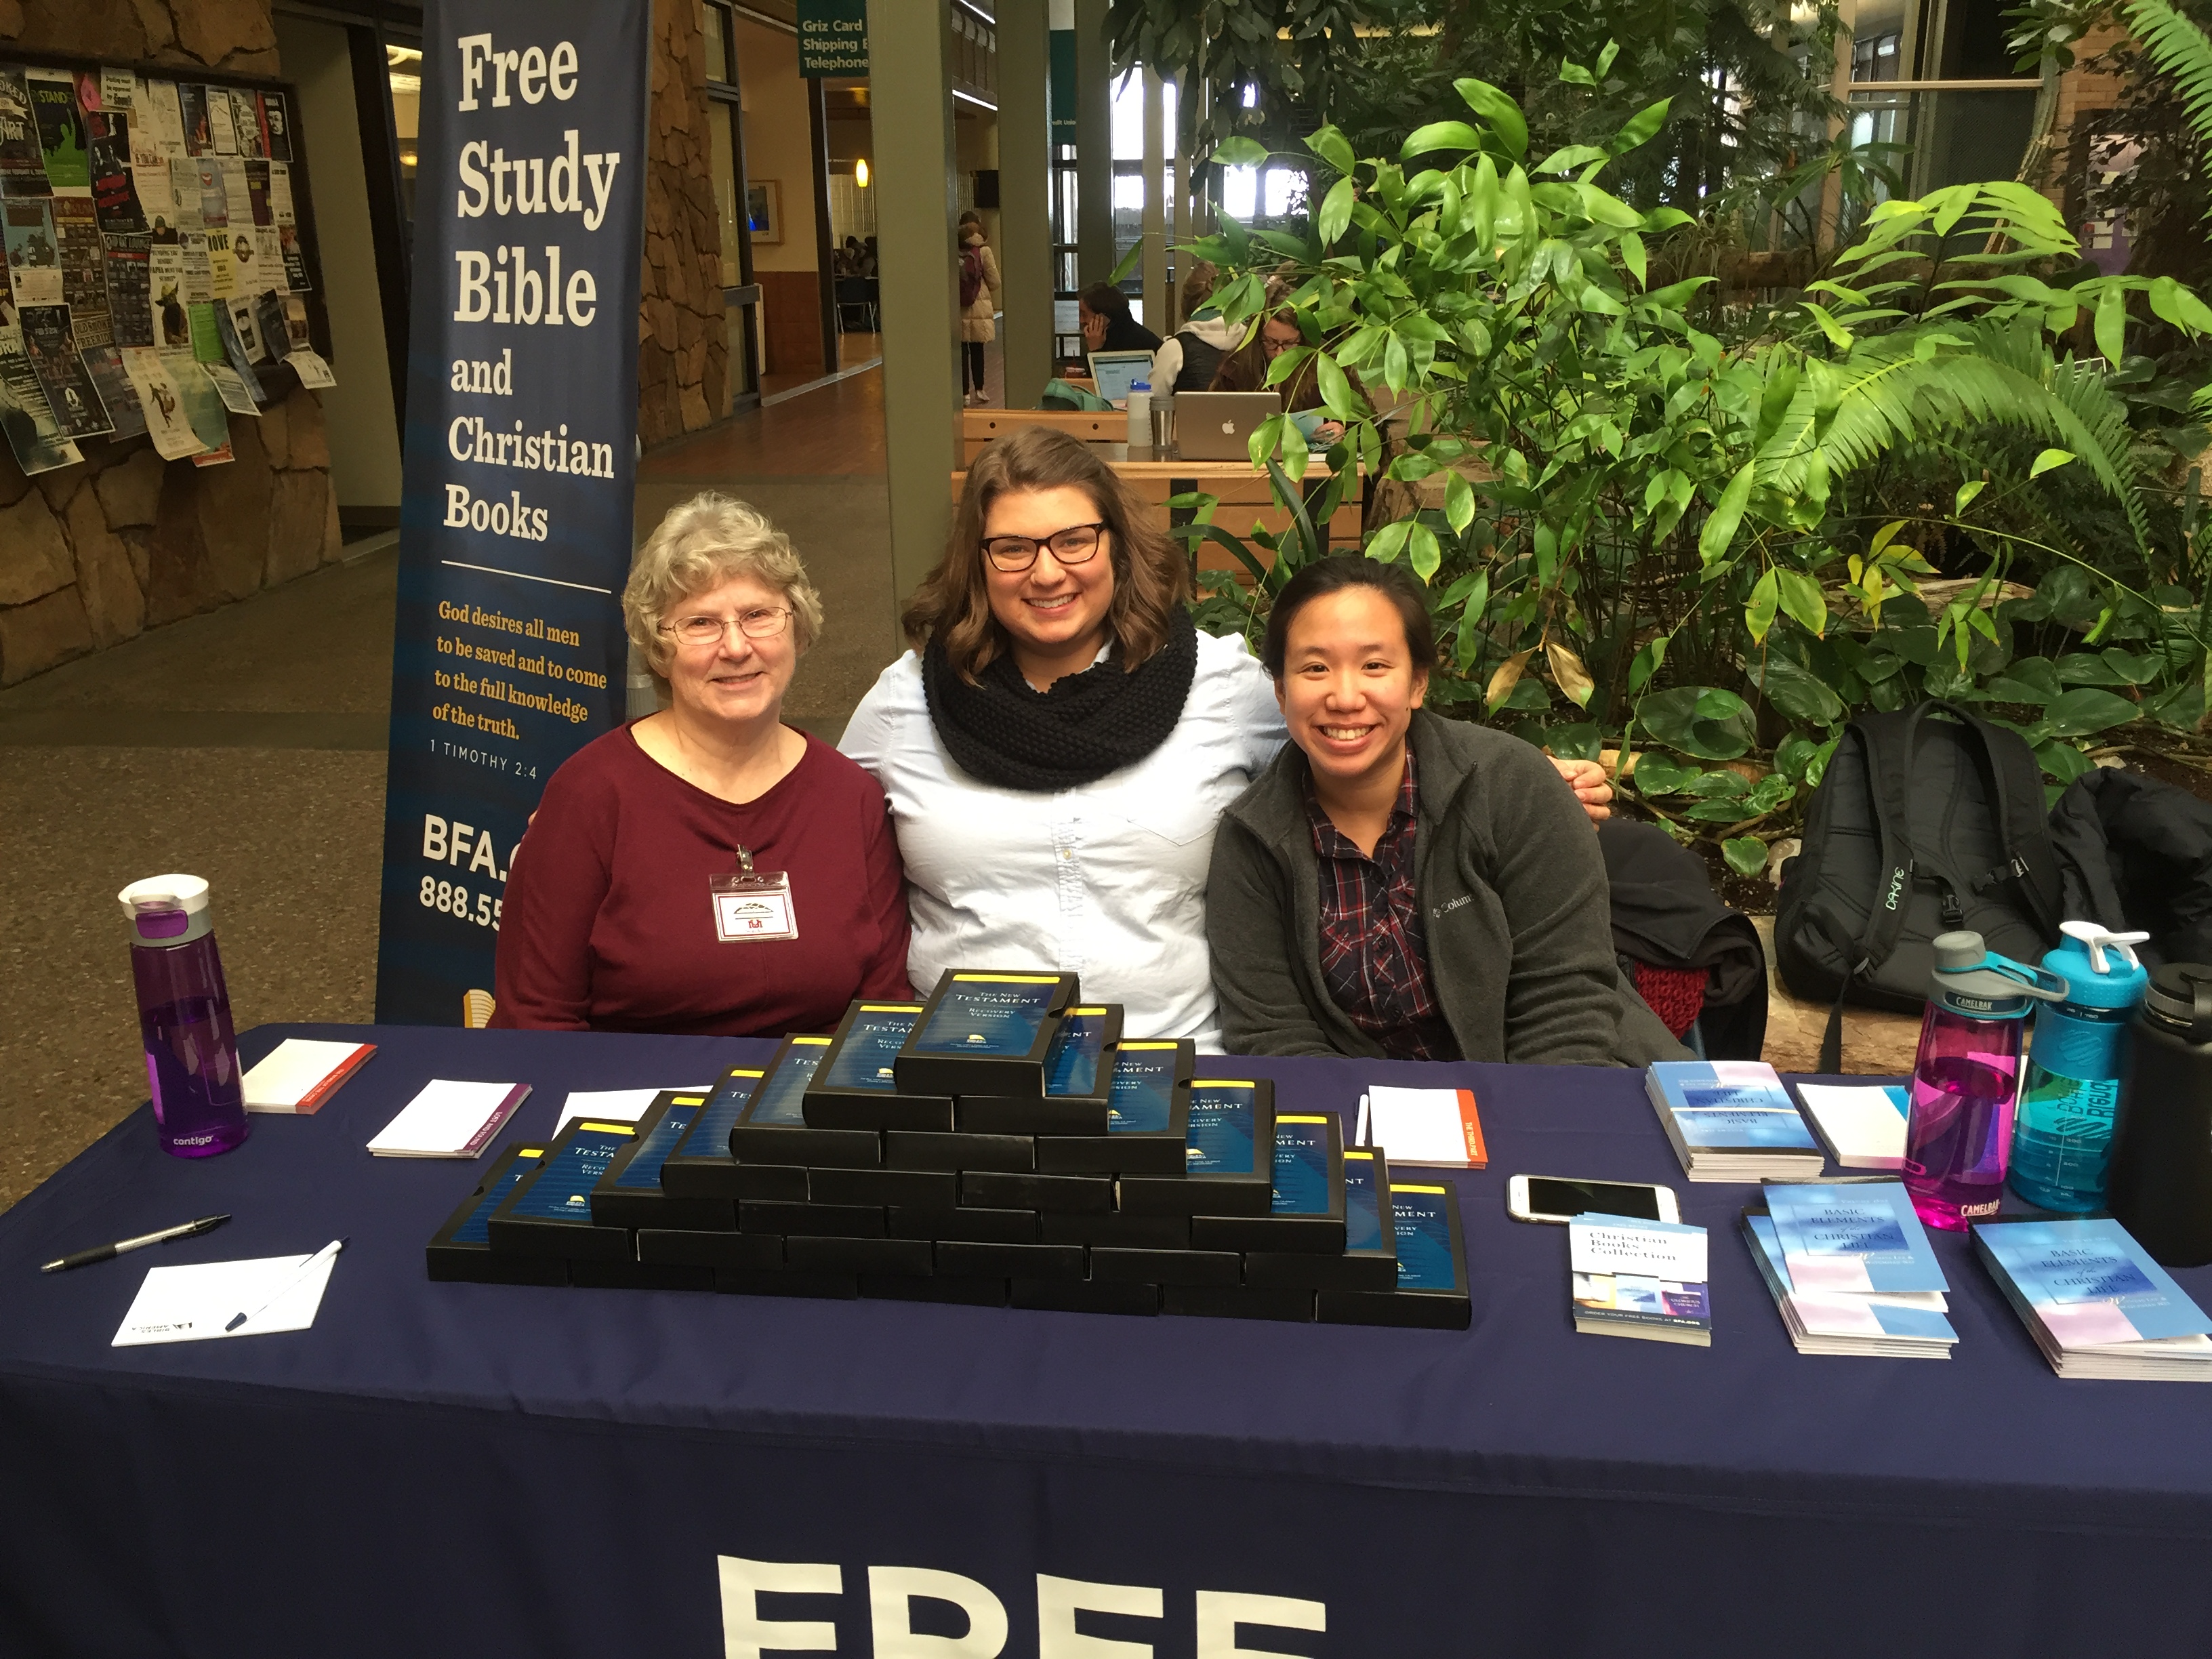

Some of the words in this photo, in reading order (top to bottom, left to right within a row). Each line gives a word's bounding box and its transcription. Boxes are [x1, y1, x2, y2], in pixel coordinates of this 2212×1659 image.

[802, 19, 829, 33] Griz
[833, 18, 863, 32] Card
[803, 38, 858, 53] Shipping
[457, 33, 578, 112] Free
[804, 56, 869, 70] Telephone
[457, 129, 620, 231] Study
[453, 245, 597, 327] Bible
[451, 348, 512, 396] and
[448, 415, 615, 479] Christian
[443, 483, 548, 541] Books
[438, 600, 469, 623] God
[472, 606, 523, 635] desires
[525, 618, 544, 639] all
[547, 626, 580, 647] men
[436, 636, 453, 655] to
[455, 636, 473, 659] be
[475, 644, 516, 668] saved
[518, 655, 545, 676] and
[548, 660, 563, 680] to
[566, 667, 607, 690] come
[434, 670, 451, 688] to
[453, 672, 478, 694] the
[479, 677, 506, 701] full
[508, 684, 588, 724] knowledge
[432, 702, 451, 721] of
[451, 705, 475, 728] the
[477, 713, 520, 740] truth.
[430, 739, 436, 752] 1
[443, 742, 508, 771] TIMOTHY
[515, 762, 537, 780] 2:4
[423, 813, 520, 882] BFA.
[1885, 866, 1905, 911] DAKINE
[956, 994, 1042, 1004] TESTAMENT
[1956, 996, 1993, 1011] CAMELBAK
[173, 1134, 213, 1146] contigo
[1590, 1232, 1667, 1244] Christian
[1591, 1240, 1639, 1249] Books
[1591, 1248, 1676, 1261] Collection
[2041, 1256, 2118, 1268] ELEMENTS
[2050, 1248, 2093, 1257] BASIC
[2053, 1273, 2136, 1286] CHRISTIAN
[2087, 1285, 2120, 1294] LIFE
